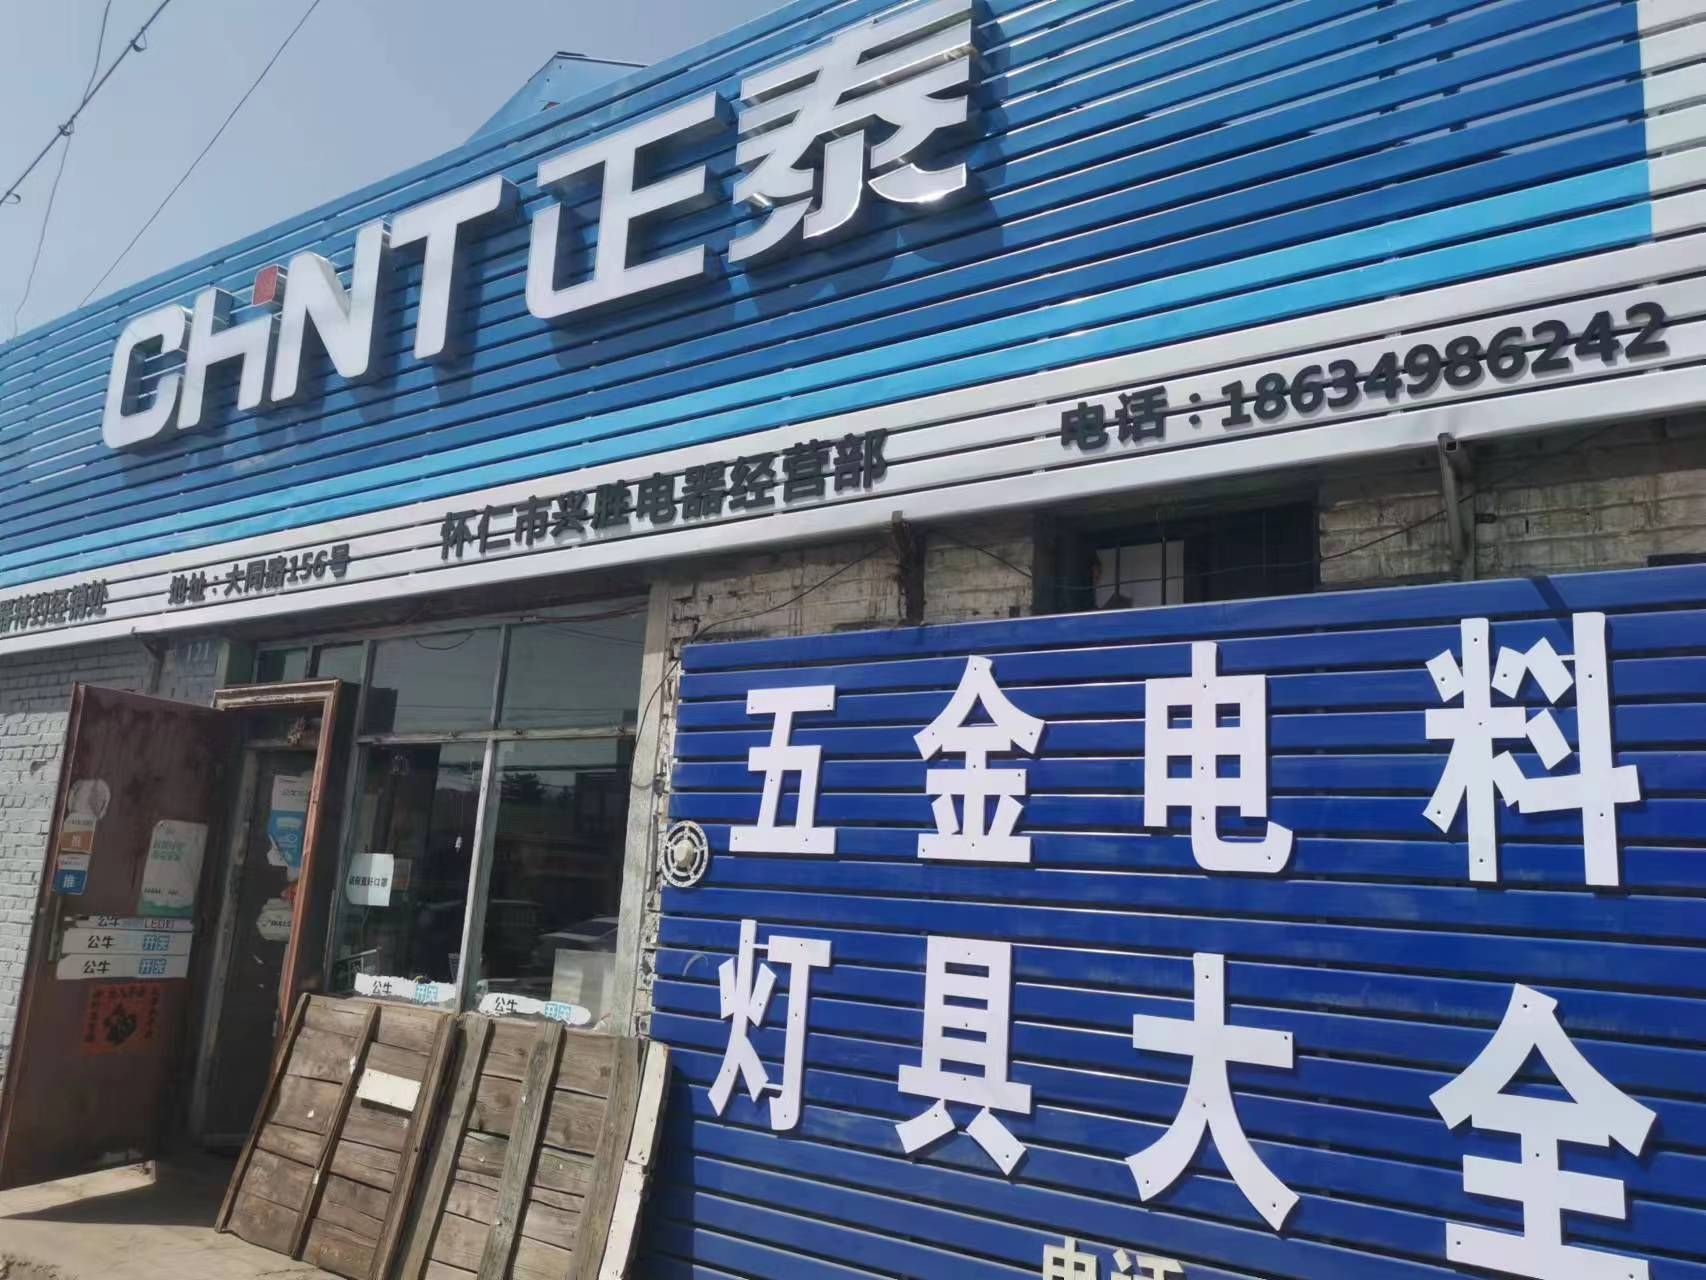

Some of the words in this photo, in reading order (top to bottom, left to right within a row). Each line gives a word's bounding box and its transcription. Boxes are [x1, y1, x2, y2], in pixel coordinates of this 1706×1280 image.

[525, 0, 978, 320] 正泰
[1061, 301, 1668, 450] 电话：18634986242
[441, 428, 889, 560] 怀仁市兴胜电器经营部
[728, 611, 1640, 887] 五金电料
[83, 960, 111, 974] 公牛
[87, 935, 115, 949] 公牛
[707, 919, 1657, 1280] 灯具大全
